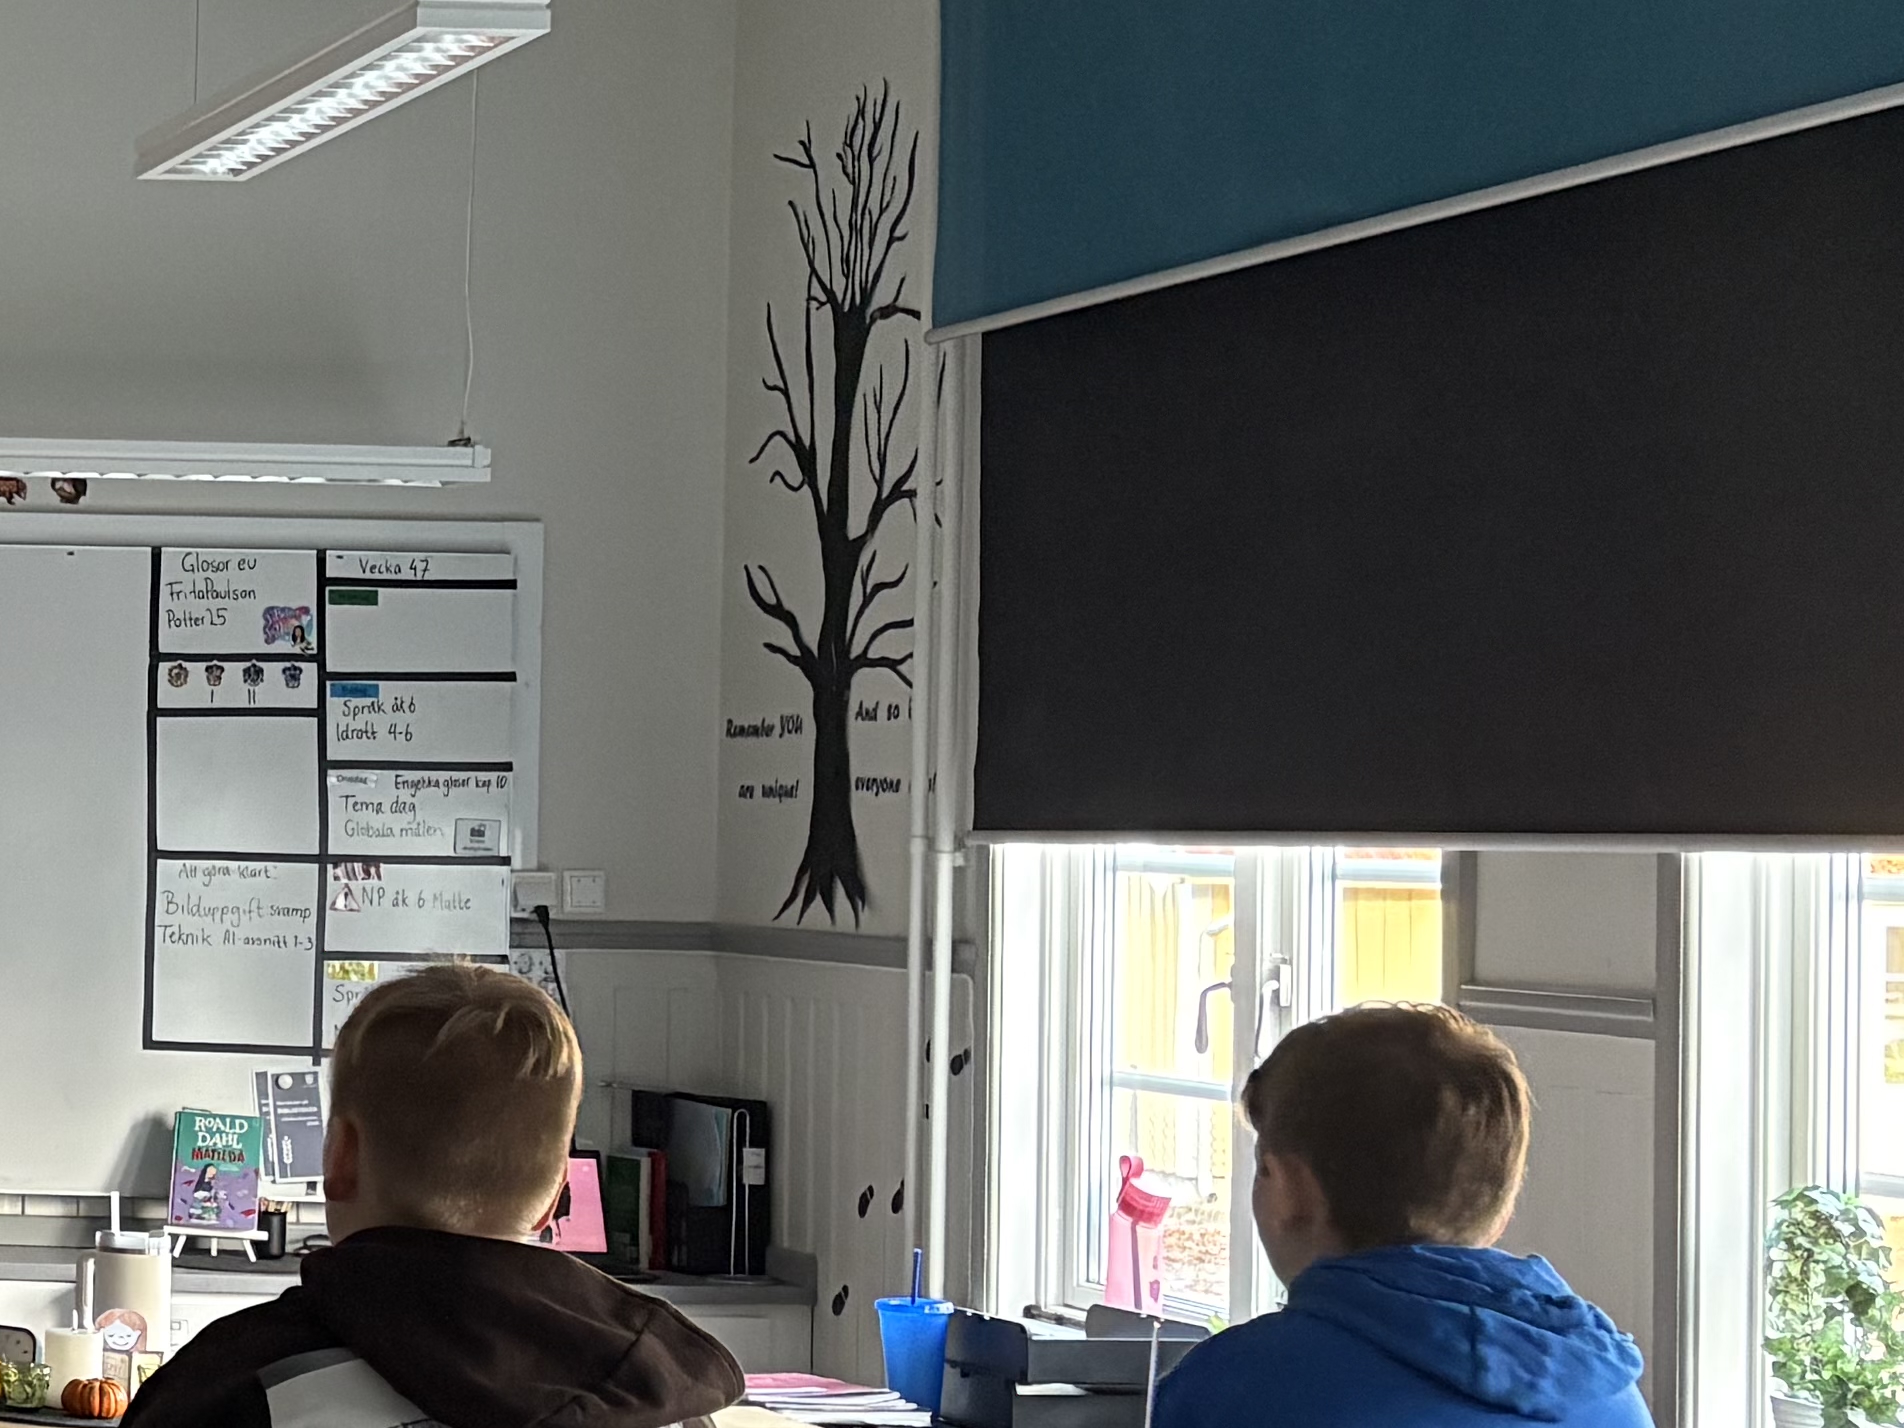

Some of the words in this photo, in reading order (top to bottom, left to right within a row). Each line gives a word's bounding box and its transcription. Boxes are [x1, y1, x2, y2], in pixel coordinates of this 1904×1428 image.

[359, 557, 402, 575] Vecka
[409, 558, 431, 579] 47
[855, 700, 880, 722] And
[886, 703, 901, 721] so
[388, 723, 413, 742] 4-6
[855, 775, 902, 797] everyone
[339, 794, 385, 815] Tema
[390, 795, 417, 821] dag
[160, 889, 266, 928] Bilduppgift
[361, 886, 385, 906] NP
[392, 889, 409, 908] åk
[417, 890, 426, 909] 6
[157, 924, 213, 947] Teknik
[194, 1115, 249, 1134] ROALD
[196, 1131, 243, 1149] DAHL
